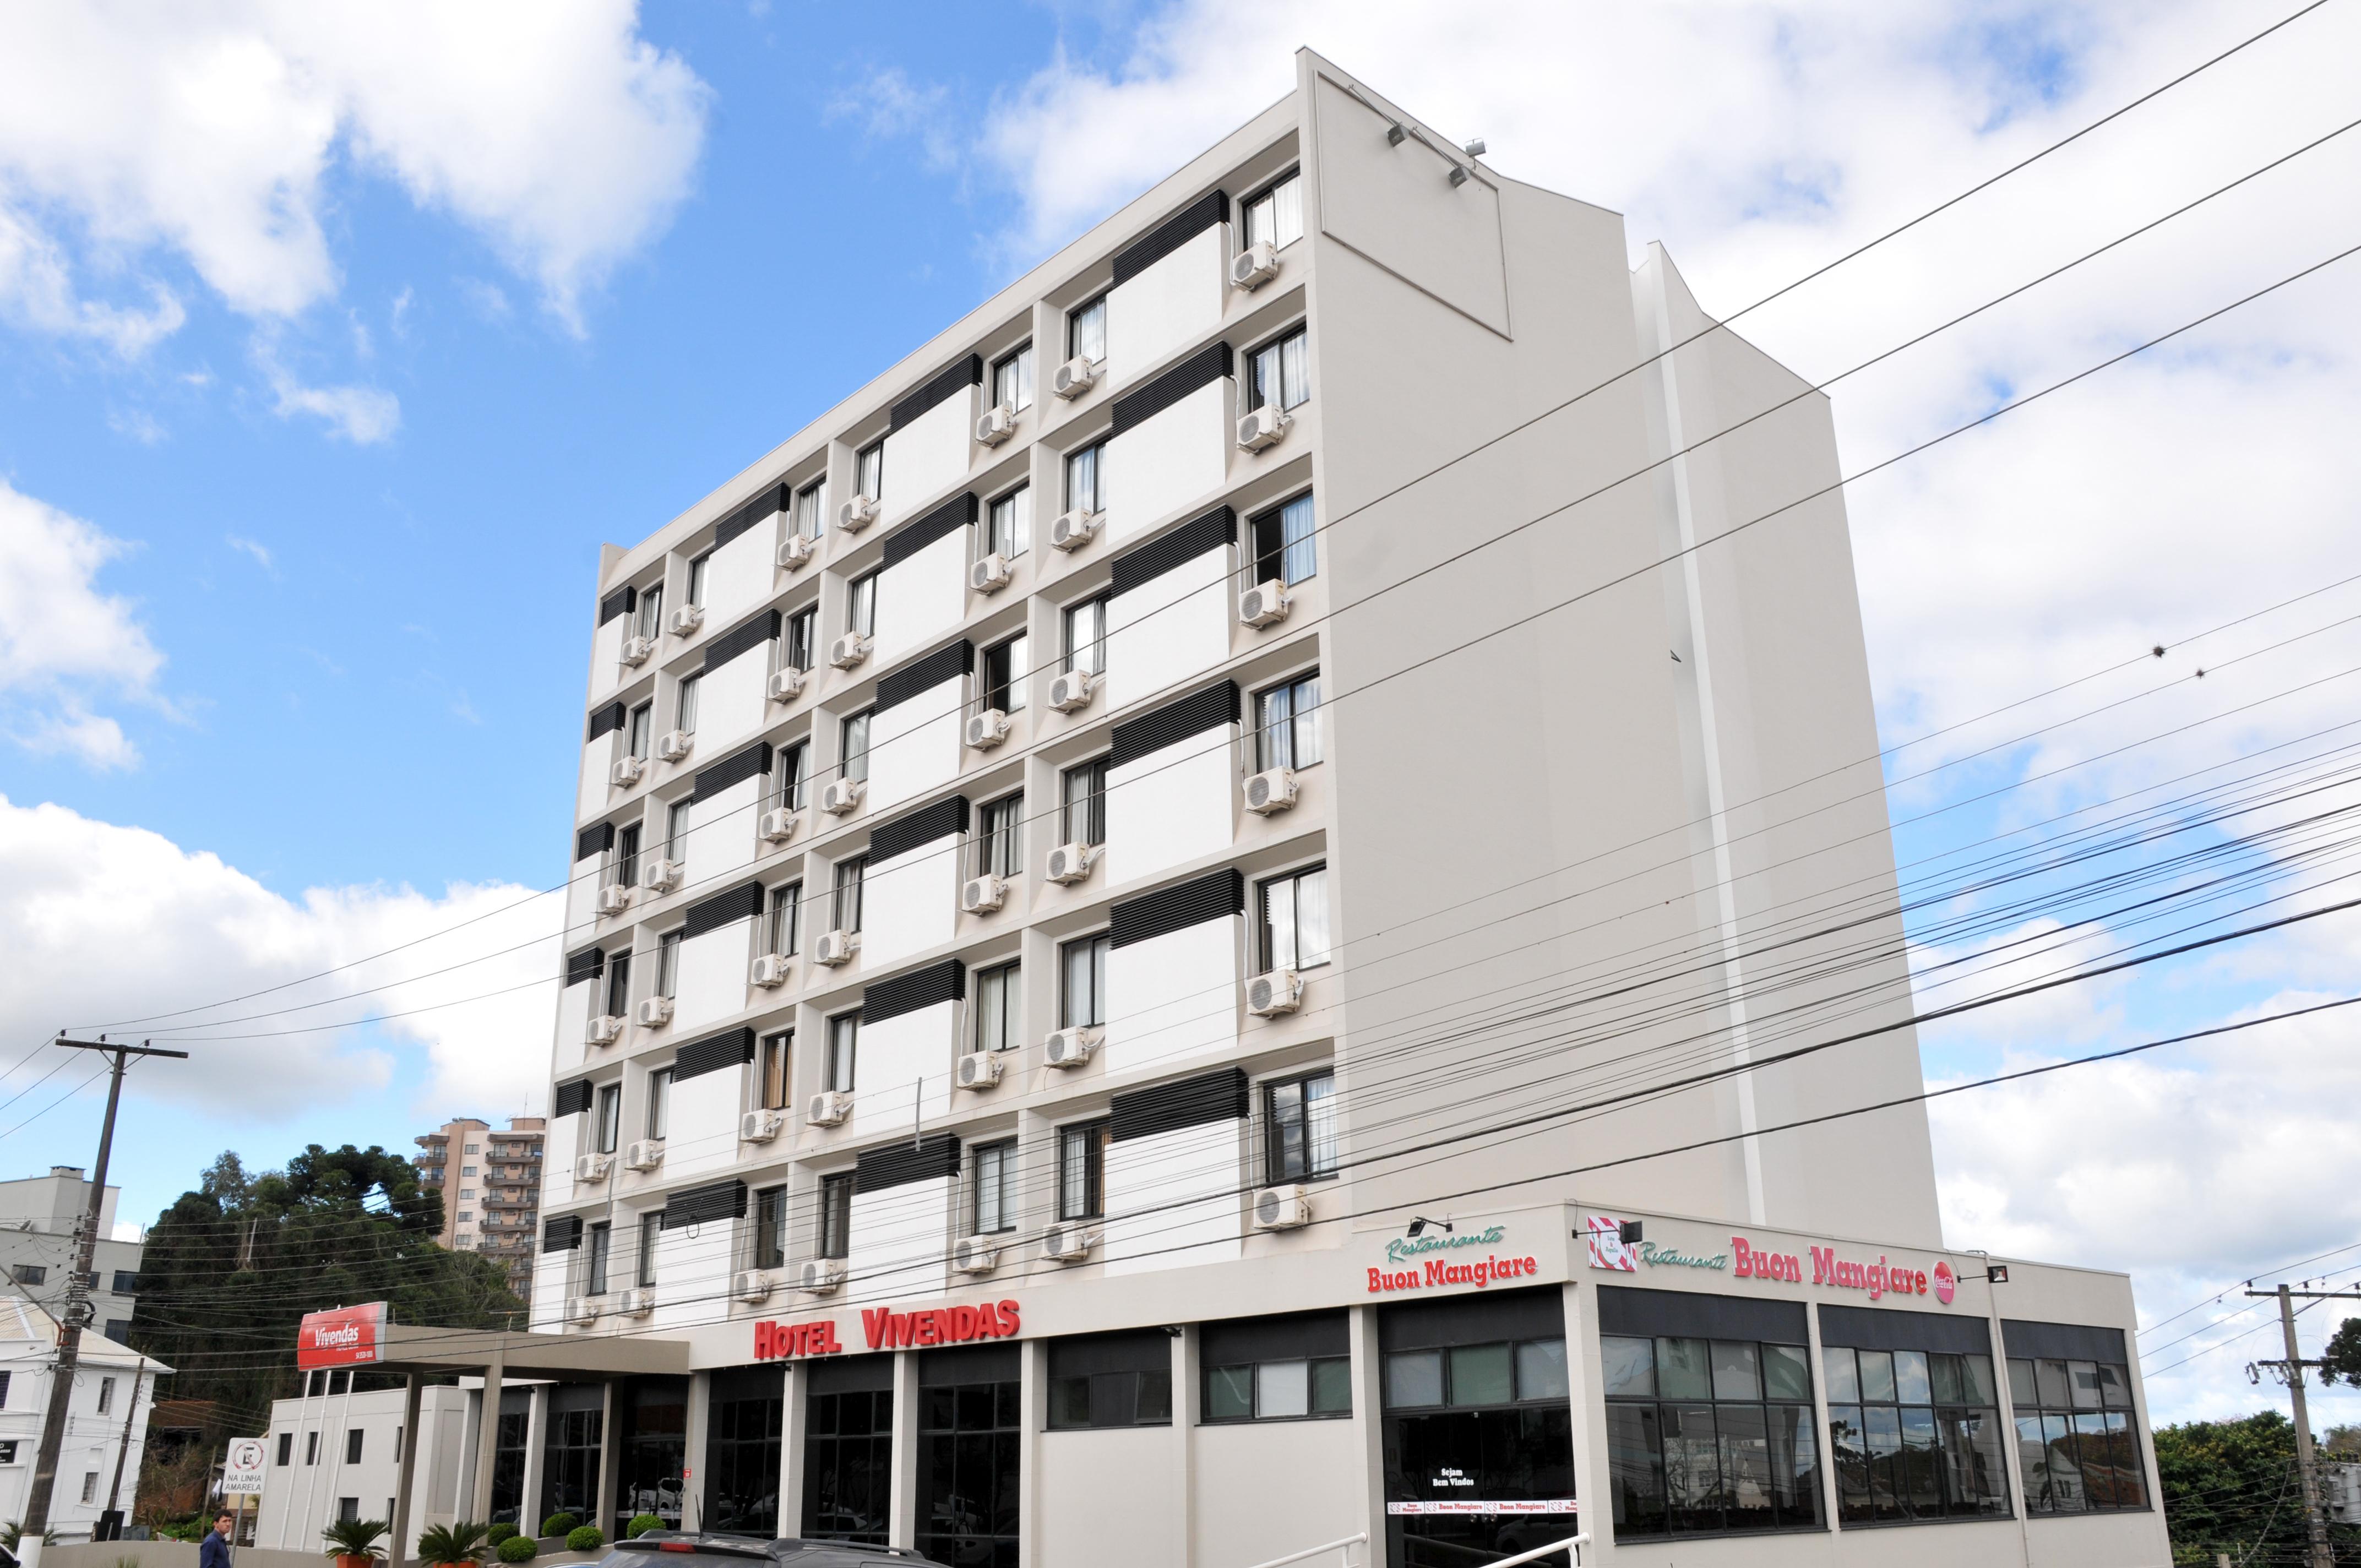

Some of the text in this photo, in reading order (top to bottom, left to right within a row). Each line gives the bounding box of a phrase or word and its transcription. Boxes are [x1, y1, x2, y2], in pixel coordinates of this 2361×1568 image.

[1385, 1226, 1506, 1264] Restaurante
[1367, 1254, 1537, 1293] Buon Mangiare
[1640, 1237, 1927, 1300] Restaurante Buon Mangiare
[315, 1322, 359, 1348] Vivendas
[754, 1299, 1020, 1359] HOTEL VIVENDAS
[1433, 1477, 1475, 1487] Bem Vindos
[1441, 1467, 1463, 1478] Sejam
[1515, 1502, 1546, 1511] Mangiare
